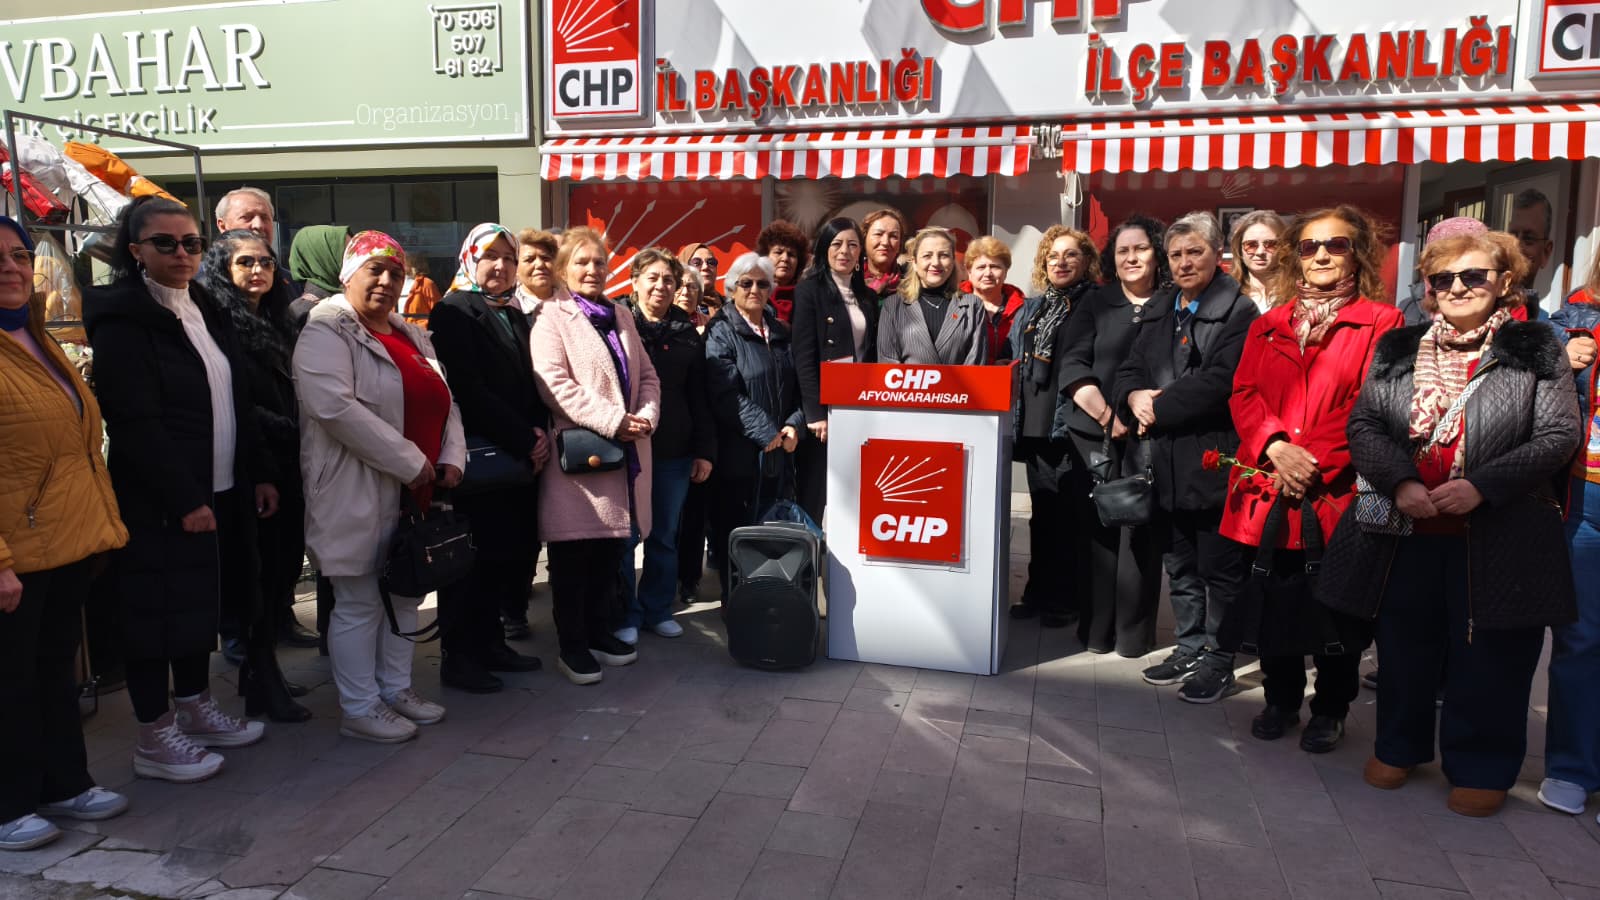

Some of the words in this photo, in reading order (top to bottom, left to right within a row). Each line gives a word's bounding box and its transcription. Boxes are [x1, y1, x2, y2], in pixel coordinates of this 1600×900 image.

[441, 12, 454, 31] 0
[458, 9, 495, 31] 506
[451, 34, 485, 55] 507
[1085, 33, 1185, 101] İLÇE
[1202, 15, 1512, 95] BAŞKANLIĞI
[0, 23, 270, 104] VBAHAR
[468, 57, 494, 77] 62
[559, 67, 634, 108] CHP
[656, 58, 688, 113] İL
[699, 48, 934, 118] BAŞKANLIĞI
[55, 103, 217, 144] ÇİÇEKÇİLİK
[356, 101, 511, 131] Organizasyon
[884, 368, 941, 390] CHP
[871, 513, 949, 544] CHP
